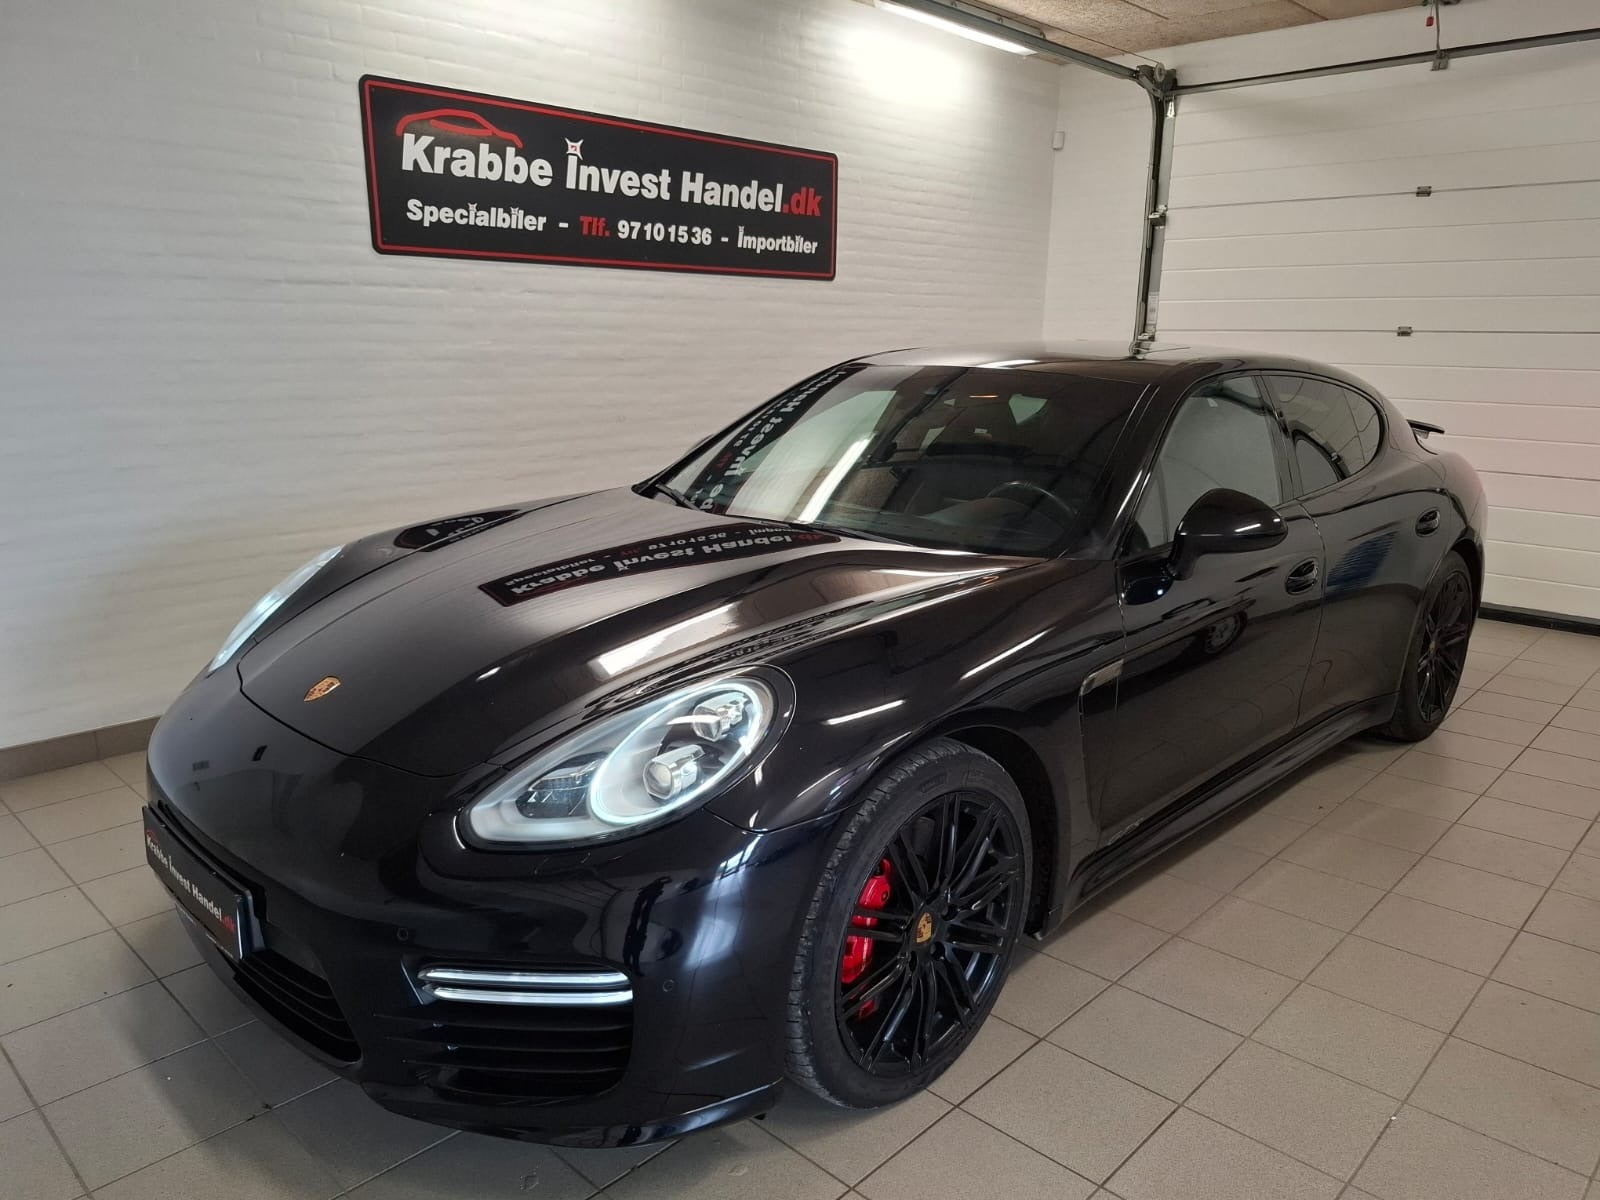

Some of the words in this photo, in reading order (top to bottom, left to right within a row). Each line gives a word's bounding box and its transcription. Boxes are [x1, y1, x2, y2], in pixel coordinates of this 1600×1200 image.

[402, 133, 553, 187] Krabbe
[565, 138, 671, 201] Invest
[680, 171, 823, 216] Handel.dk
[406, 198, 547, 231] Specialbiler
[580, 216, 610, 237] Tlf.
[737, 226, 818, 254] Importbiler
